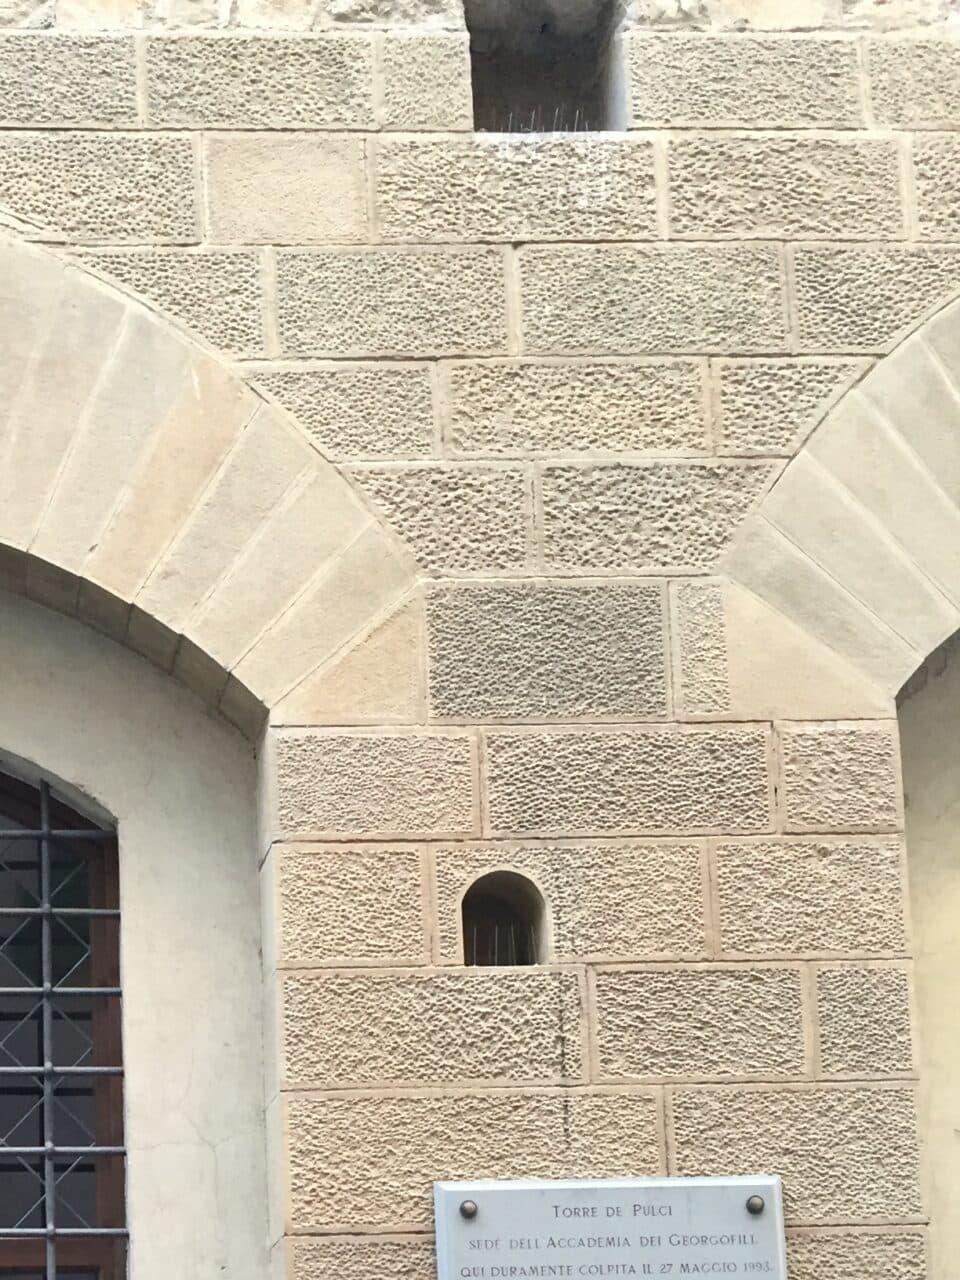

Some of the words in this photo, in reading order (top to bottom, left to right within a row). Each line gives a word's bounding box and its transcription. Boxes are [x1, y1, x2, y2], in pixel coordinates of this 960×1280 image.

[606, 1206, 623, 1217] DE
[469, 1238, 501, 1249] SEDE
[546, 1236, 631, 1249] ACCADEMIA
[639, 1235, 662, 1247] DEI
[460, 1267, 485, 1278] QUI
[491, 1264, 573, 1277] DURAMENTE
[579, 1262, 637, 1276] COLPITA
[642, 1262, 653, 1274] IL
[659, 1262, 673, 1273] 27
[680, 1260, 737, 1273] MAGGIO
